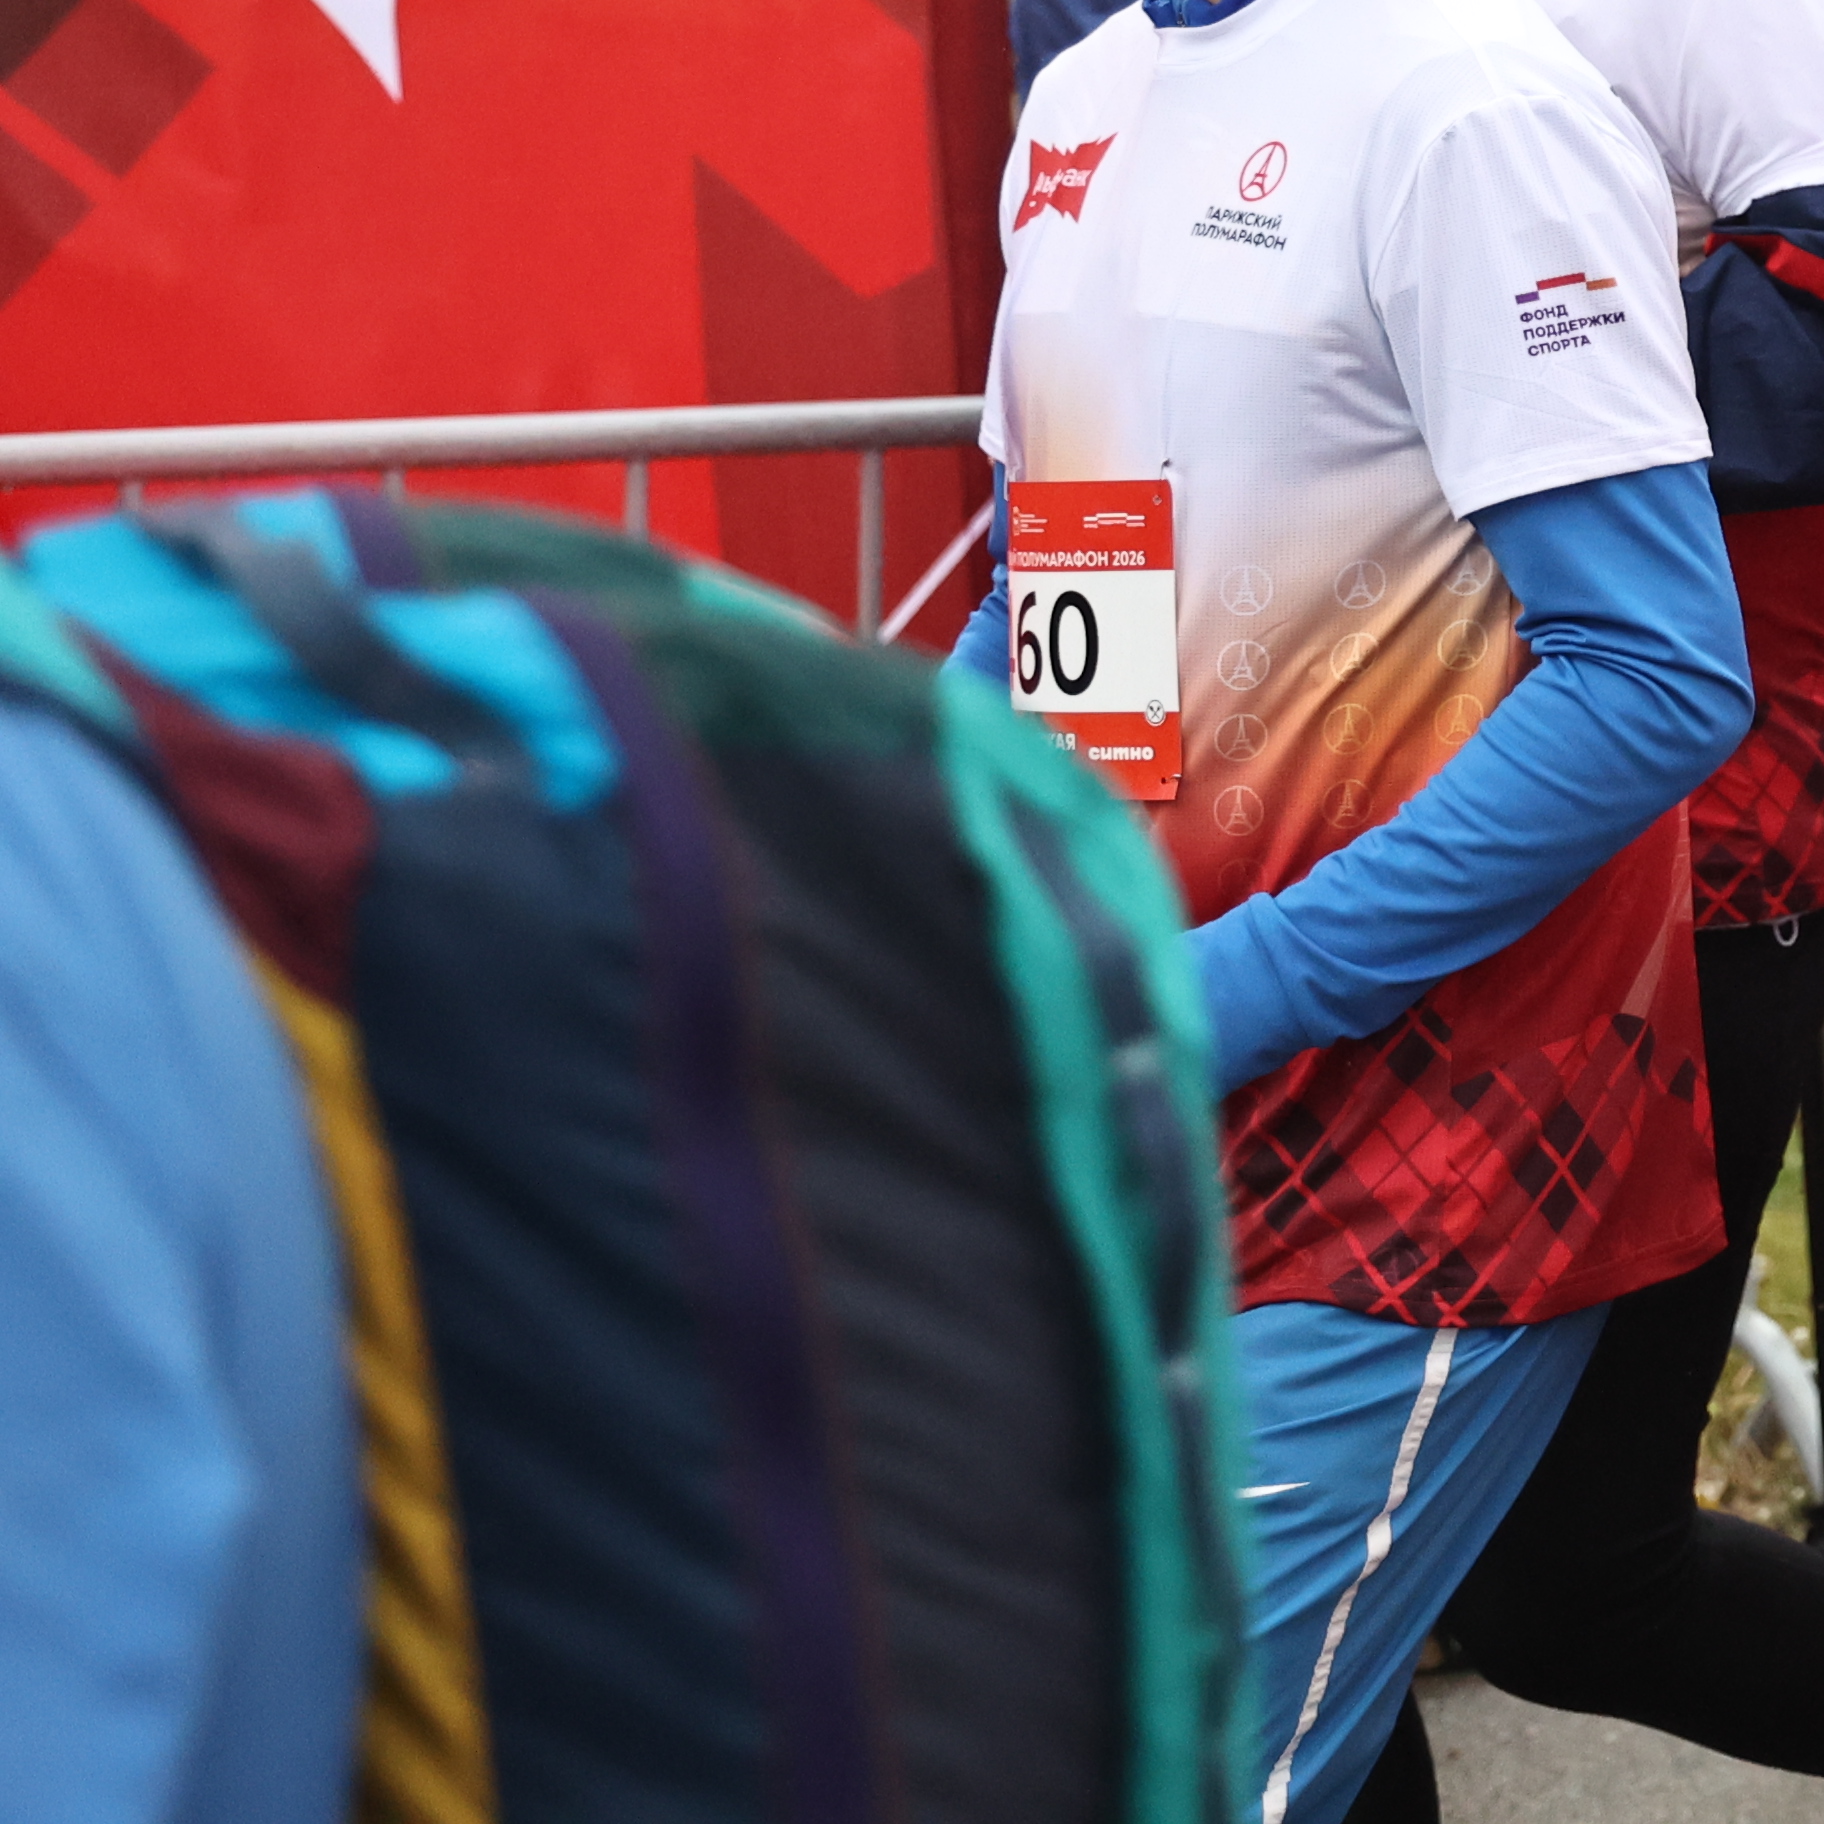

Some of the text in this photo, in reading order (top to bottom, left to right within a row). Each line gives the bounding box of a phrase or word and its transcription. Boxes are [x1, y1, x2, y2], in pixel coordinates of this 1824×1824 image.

[1206, 206, 1282, 231] ПАРИЖСКИЙ
[1191, 222, 1287, 251] ПОЛУМАРАФОН
[1520, 304, 1569, 323] ФОНД
[1523, 311, 1626, 341] ПОДДЕРЖКИ
[1527, 334, 1592, 357] СПОРТА
[1112, 550, 1146, 566] 2026
[1010, 590, 1100, 696] 60
